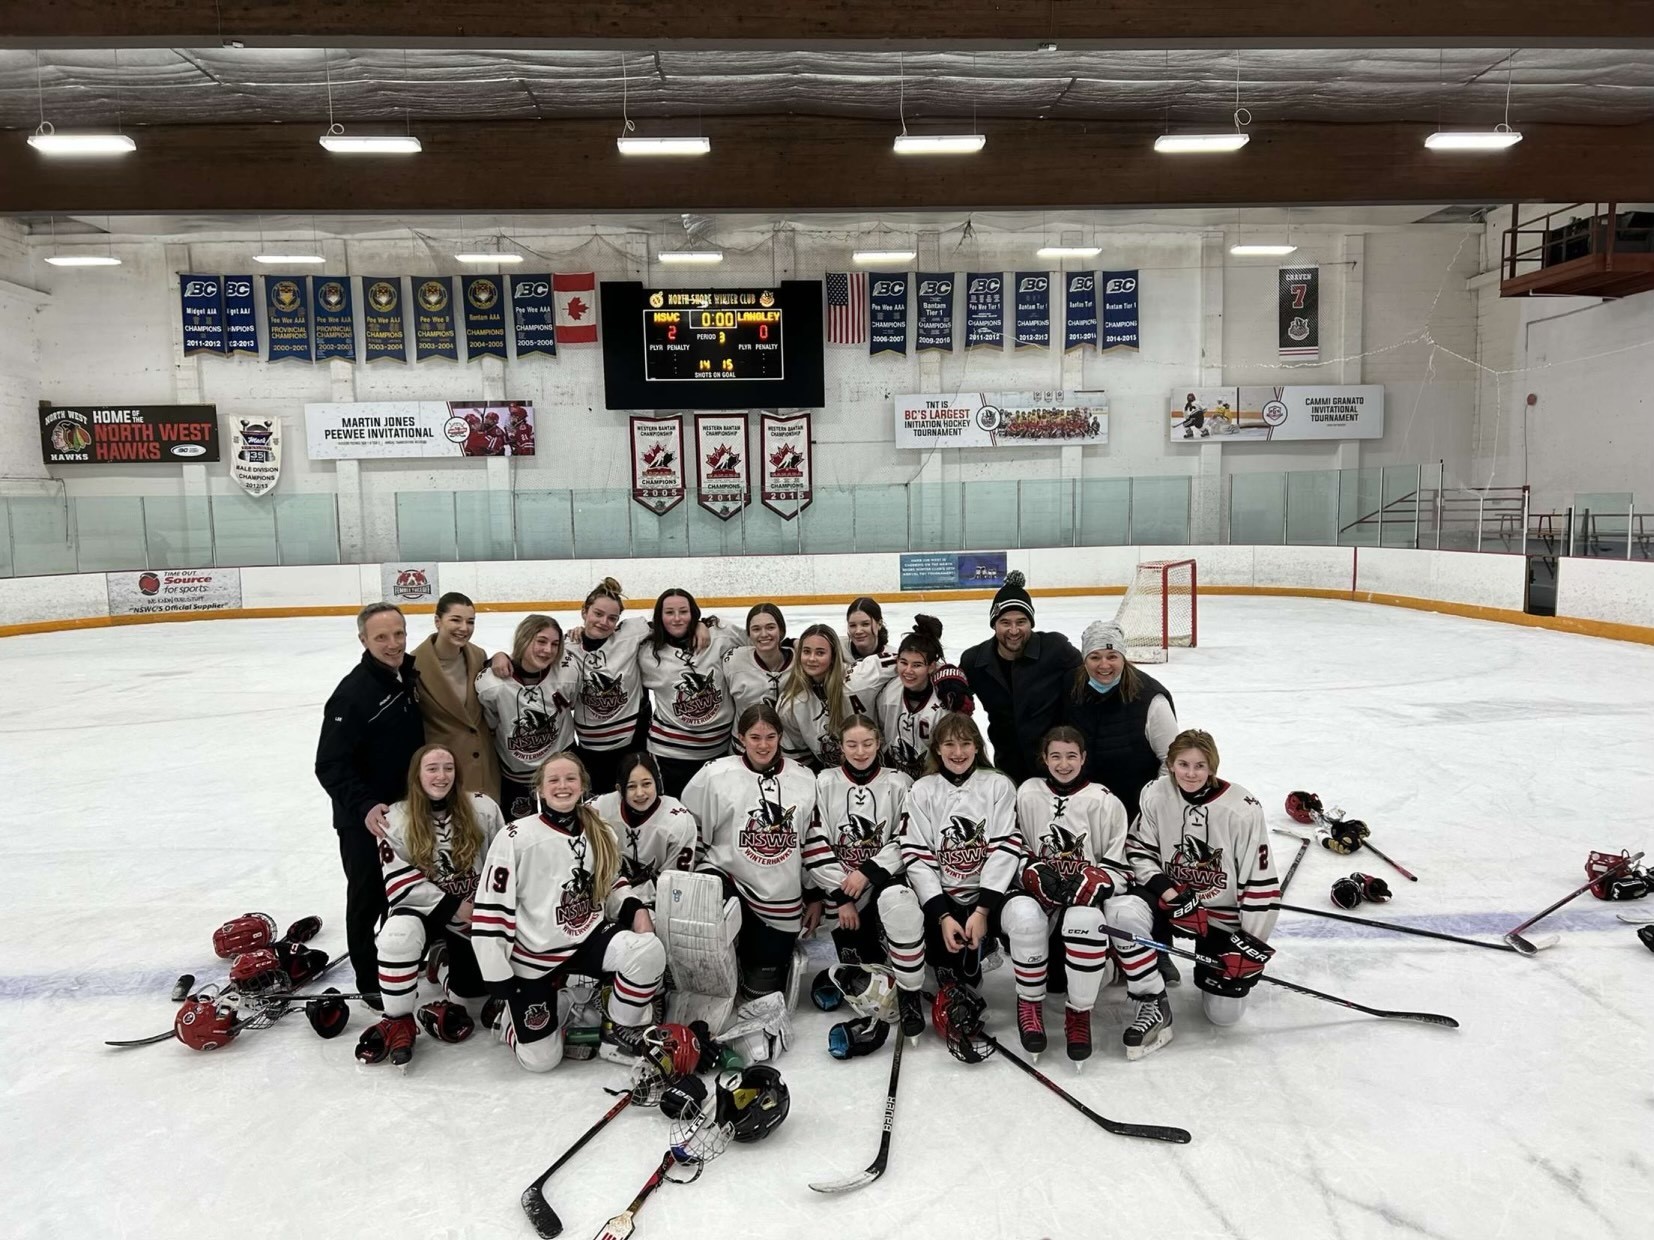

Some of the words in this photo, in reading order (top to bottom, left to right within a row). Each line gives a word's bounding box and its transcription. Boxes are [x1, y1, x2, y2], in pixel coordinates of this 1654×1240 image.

[184, 281, 217, 297] BC
[514, 282, 548, 298] BC
[872, 281, 904, 296] BC
[920, 281, 952, 296] BC
[969, 278, 1000, 294] BC
[1019, 278, 1048, 292] BC
[1106, 278, 1136, 294] BC
[668, 294, 690, 304] NORTH
[714, 294, 738, 304] WINTER
[740, 294, 756, 304] CLUB
[1291, 284, 1306, 308] 7
[654, 312, 680, 322] NSWC
[702, 312, 734, 326] 0:00
[737, 312, 780, 322] LANGLEY
[668, 326, 676, 340] 2
[720, 332, 726, 343] 3
[760, 325, 768, 339] 0
[722, 359, 734, 370] 15
[93, 410, 131, 424] HOME
[905, 410, 926, 420] BC'S
[930, 409, 970, 419] LARGEST
[1312, 406, 1358, 414] INVITATIONAL
[45, 410, 66, 426] NORTH
[68, 410, 88, 425] WEST
[342, 418, 381, 428] MARTIN
[384, 416, 414, 426] JONES
[1311, 414, 1358, 422] TOURNAMENT
[94, 424, 154, 442] NORTH
[159, 424, 211, 440] WEST
[325, 429, 365, 440] PEEWEE
[368, 428, 434, 438] INVITATIONAL
[96, 442, 160, 460] HAWKS
[164, 576, 212, 584] Source
[164, 586, 178, 594] for
[180, 585, 208, 594] sports
[672, 690, 722, 716] NSWC
[849, 694, 866, 714] A
[919, 720, 930, 739] C
[739, 830, 798, 848] NSWC
[745, 849, 792, 865] WINTERHAWKS
[1259, 844, 1268, 870] 2
[486, 865, 510, 894] 19
[1165, 862, 1228, 889] NSWC
[883, 1096, 896, 1132] BAUER
